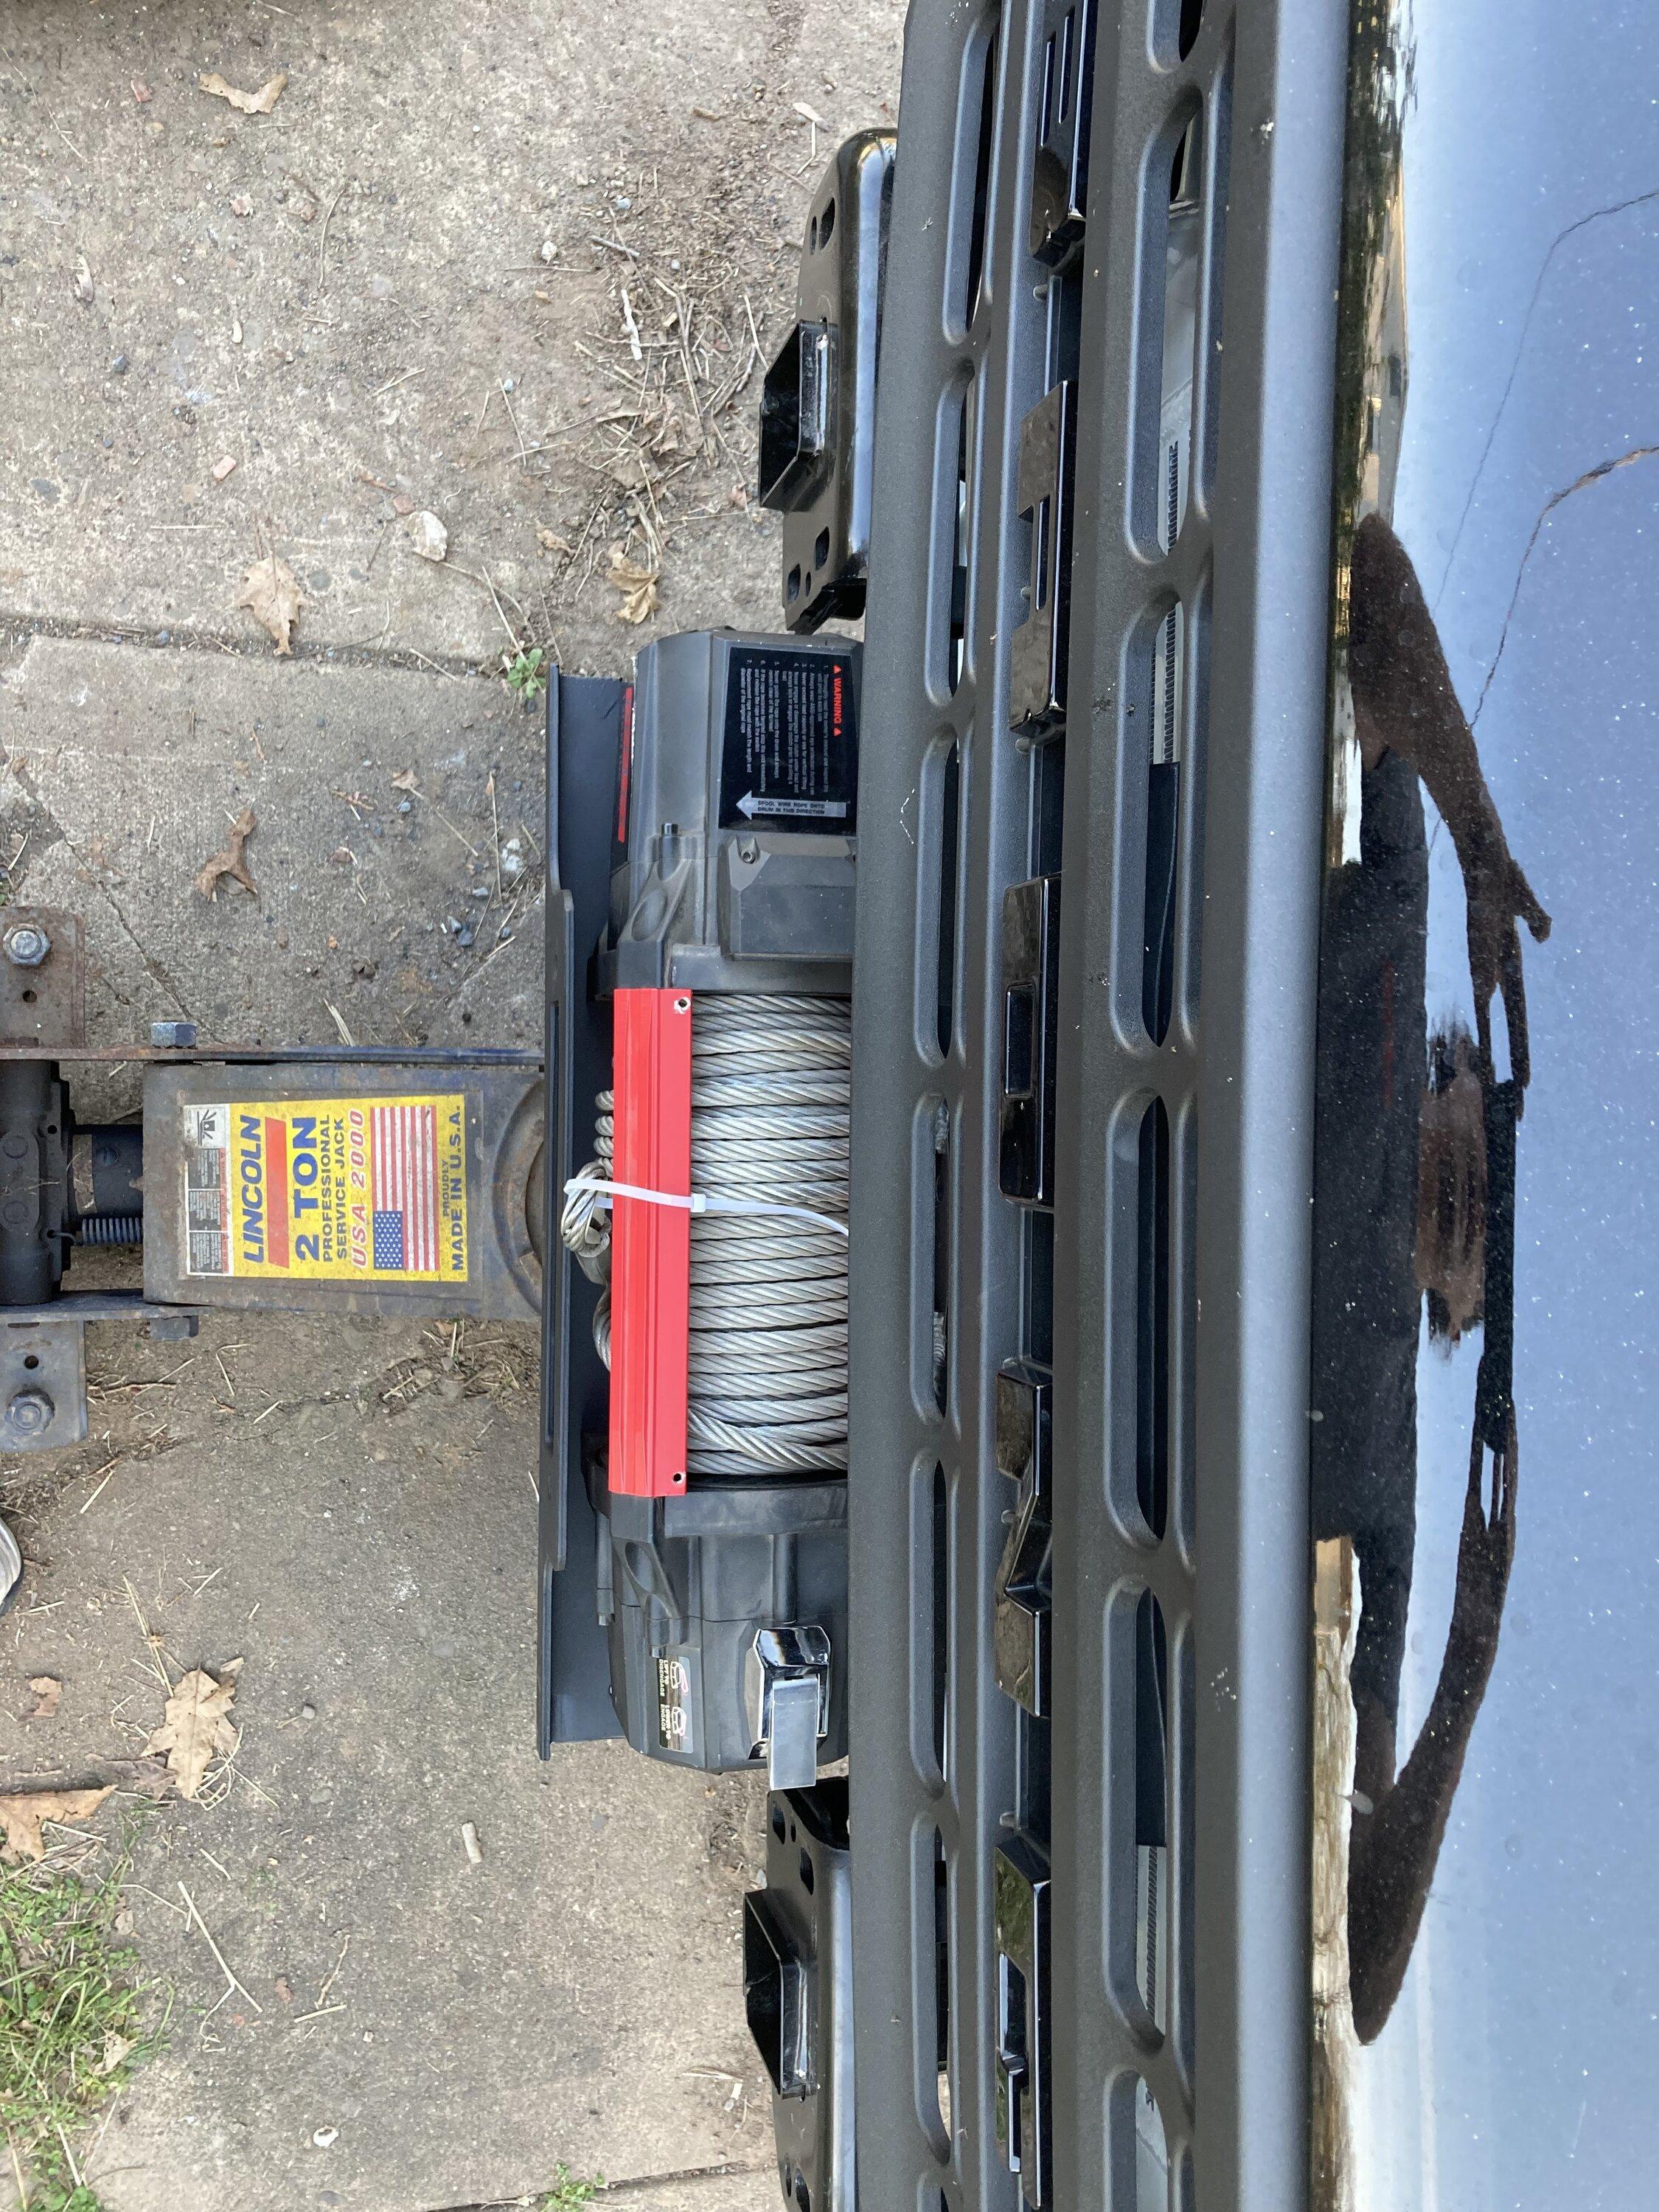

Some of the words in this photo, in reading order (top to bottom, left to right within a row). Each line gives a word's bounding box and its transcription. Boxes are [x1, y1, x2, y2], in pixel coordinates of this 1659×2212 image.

[293, 1117, 318, 1217] TON
[334, 1118, 346, 1169] JACK
[349, 1108, 366, 1189] 2000
[450, 1105, 463, 1169] U.S.A.
[240, 1115, 265, 1263] LINCOLN
[321, 1114, 333, 1262] PROFESSIONAL
[335, 1177, 347, 1259] SERVICE
[441, 1160, 450, 1217] PROUDLY
[450, 1178, 463, 1200] IN
[296, 1234, 319, 1262] 2
[350, 1205, 368, 1269] USA
[450, 1208, 464, 1271] MADE
[664, 1675, 669, 1684] TO
[666, 1731, 671, 1740] TO
